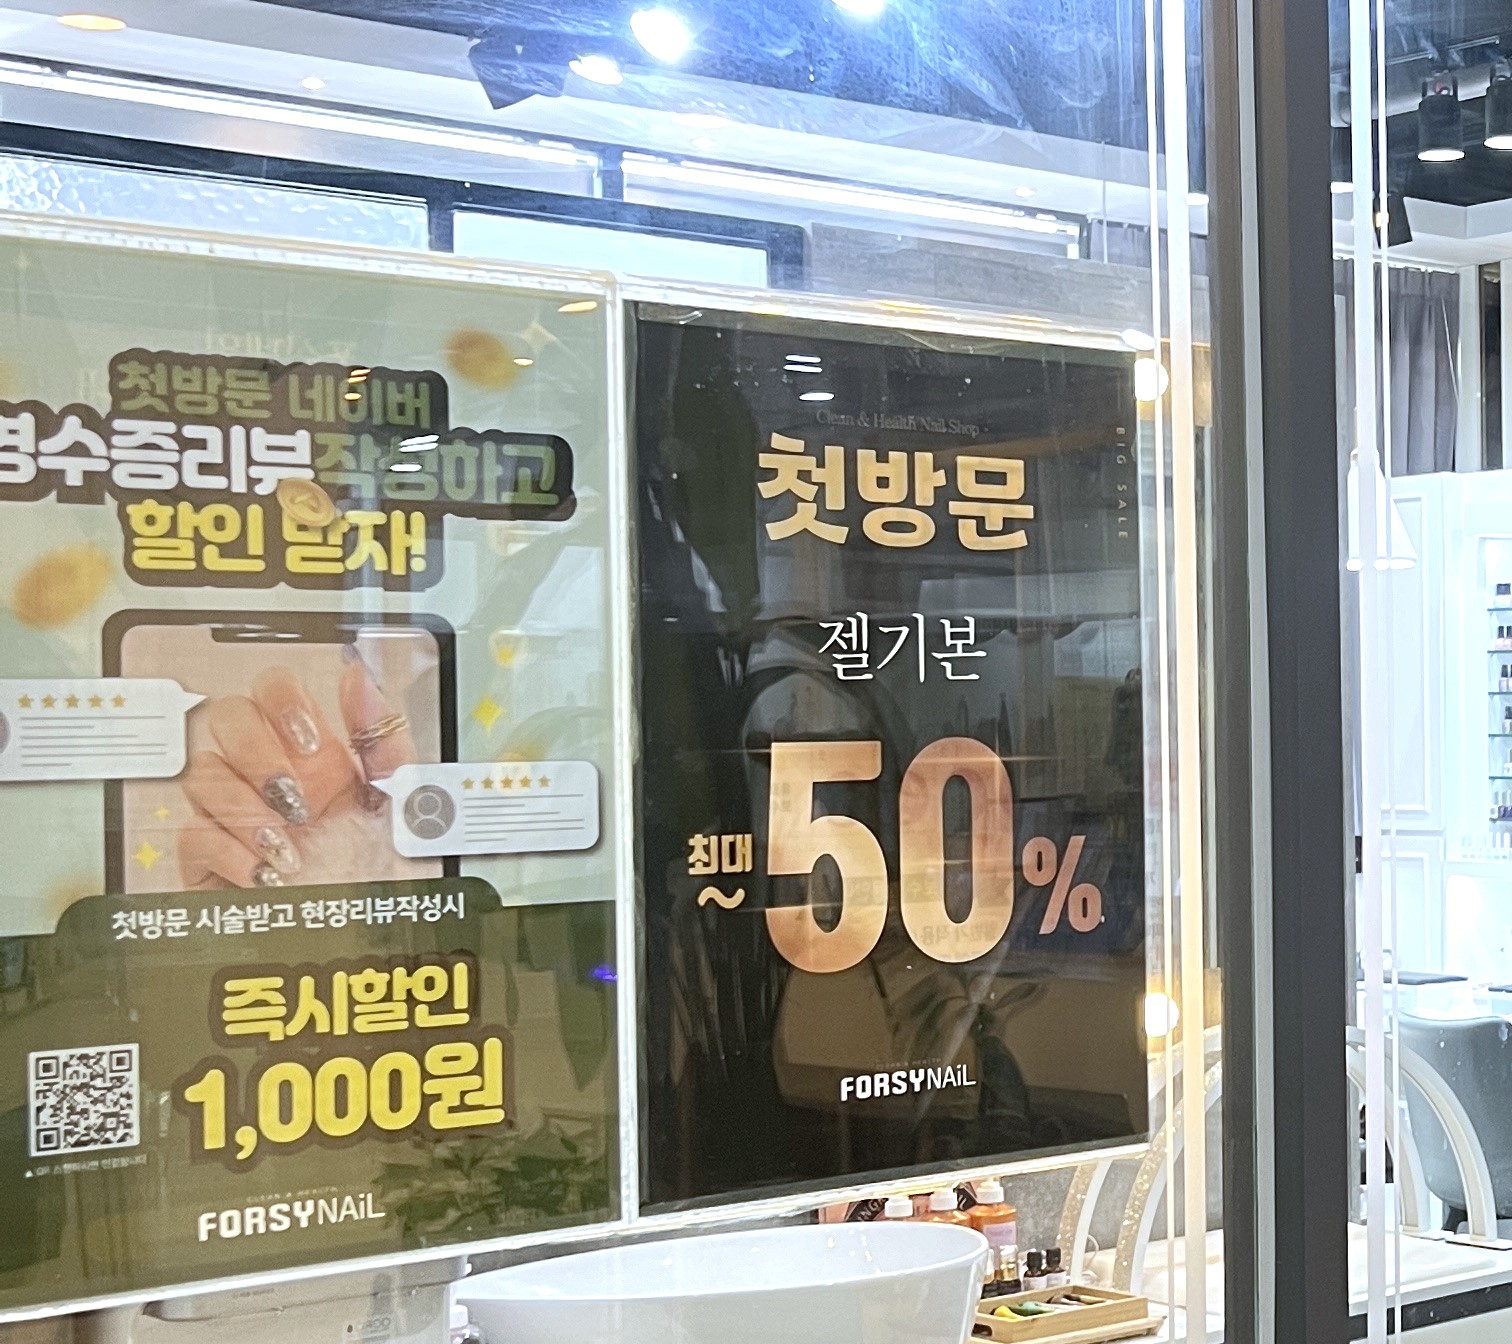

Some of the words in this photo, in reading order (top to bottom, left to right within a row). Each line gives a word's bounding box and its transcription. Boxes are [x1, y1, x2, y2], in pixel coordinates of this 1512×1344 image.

[117, 360, 273, 419] 첫방문
[289, 374, 431, 429] 네이버
[816, 409, 855, 427] Clean
[873, 413, 917, 430] Health
[948, 419, 980, 438] Shop
[1116, 427, 1126, 464] BIG
[756, 432, 1037, 552] 첫방문
[1117, 484, 1128, 538] SALE
[126, 499, 267, 573] 할인
[817, 611, 989, 683] 젤기본
[688, 833, 753, 875] 최대
[111, 910, 189, 940] 첫방문
[195, 899, 297, 936] 시술받고
[300, 892, 466, 930] 현장리뷰작성시
[221, 961, 471, 1043] 즉시할인
[184, 1036, 506, 1161] 1,000원
